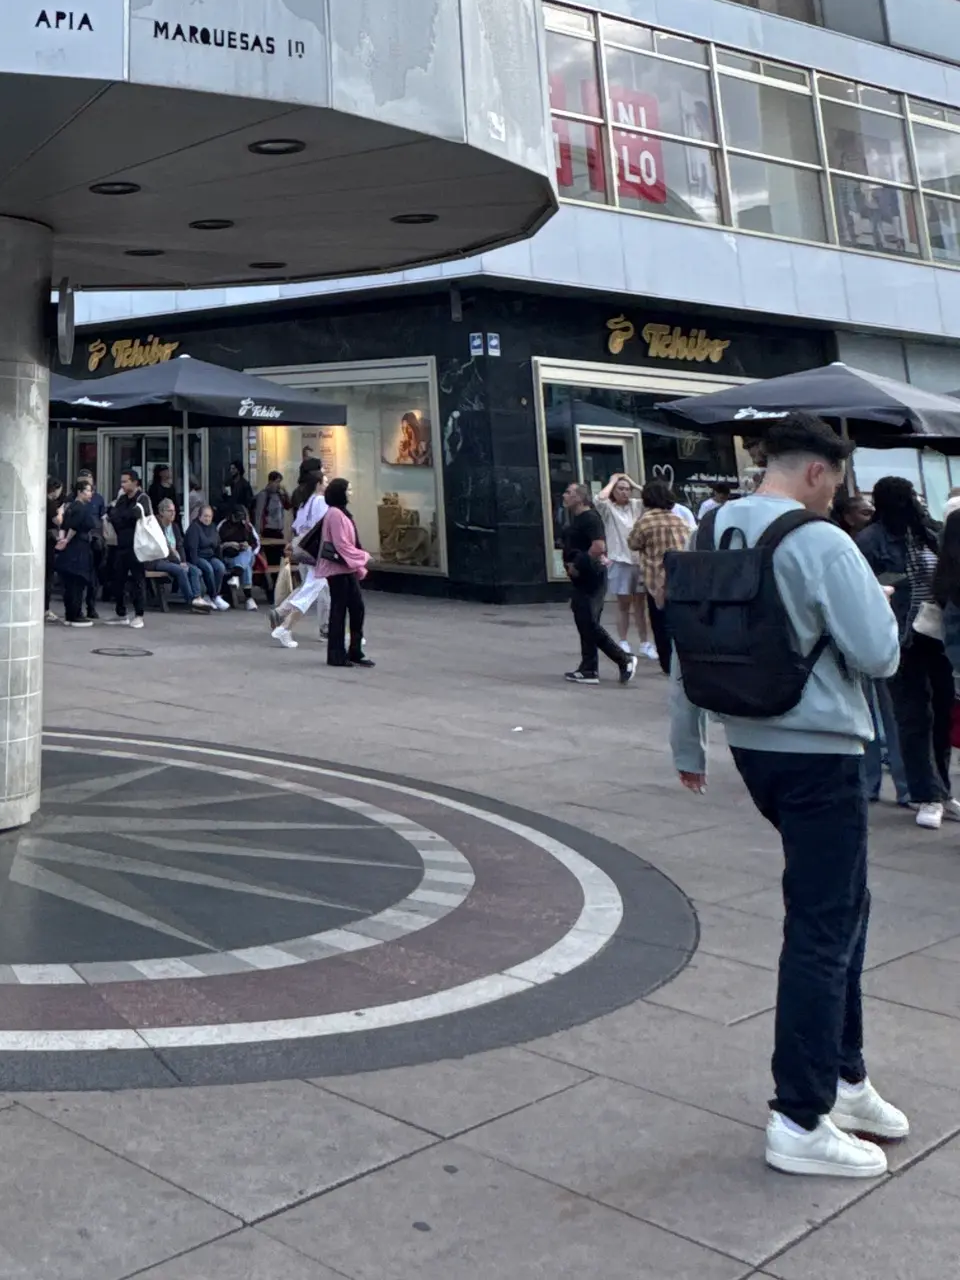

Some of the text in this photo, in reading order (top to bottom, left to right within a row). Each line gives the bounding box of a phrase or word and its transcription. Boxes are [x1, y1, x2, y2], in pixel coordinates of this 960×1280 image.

[34, 9, 94, 32] APIA
[153, 20, 276, 55] MARQUESAS
[610, 99, 649, 142] NI
[613, 145, 658, 186] LO
[111, 334, 180, 368] Tchibo
[642, 322, 732, 363] Tchibo
